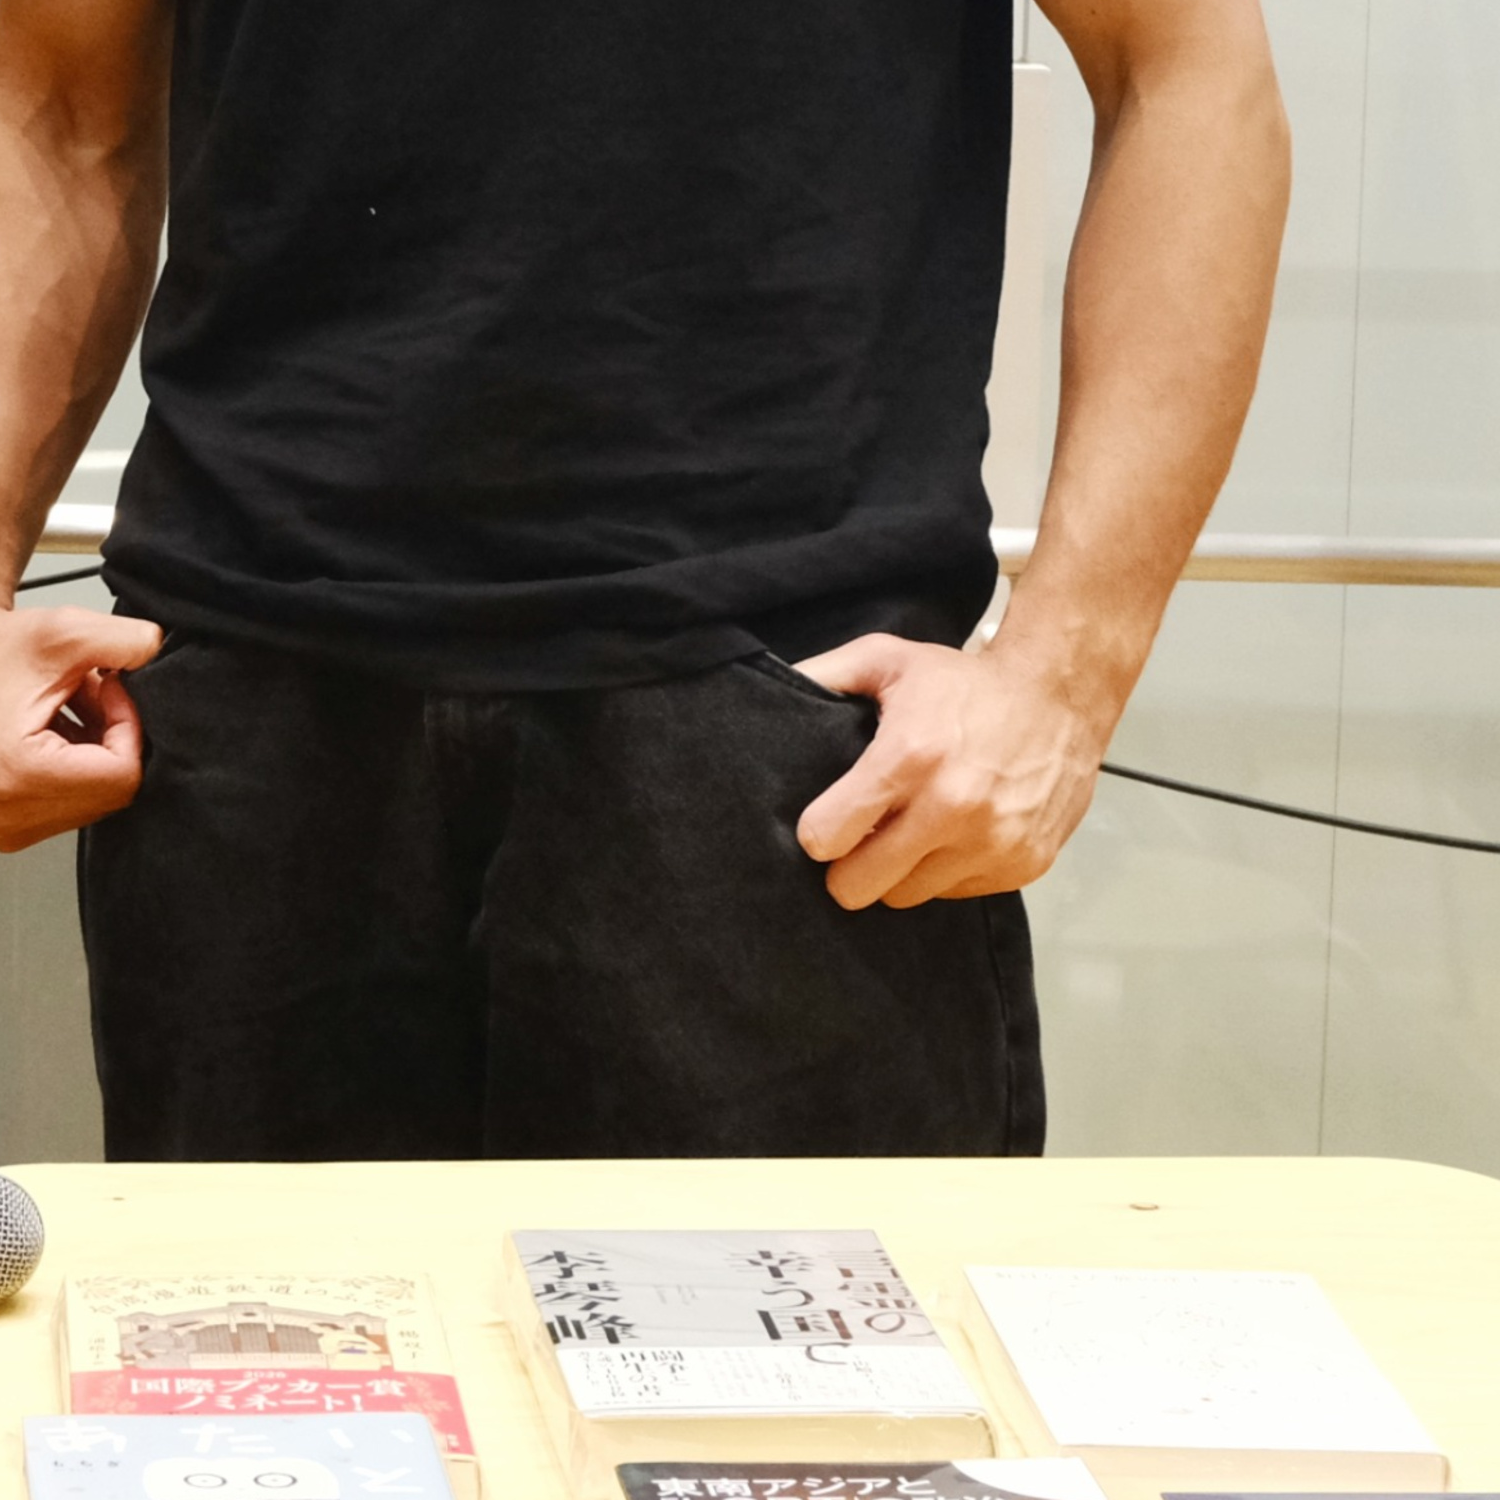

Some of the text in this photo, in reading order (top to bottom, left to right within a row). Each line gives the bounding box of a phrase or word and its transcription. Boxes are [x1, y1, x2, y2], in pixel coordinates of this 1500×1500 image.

[131, 1377, 405, 1397] 国際ブッカー賞
[650, 1476, 936, 1496] 東南アジアと
